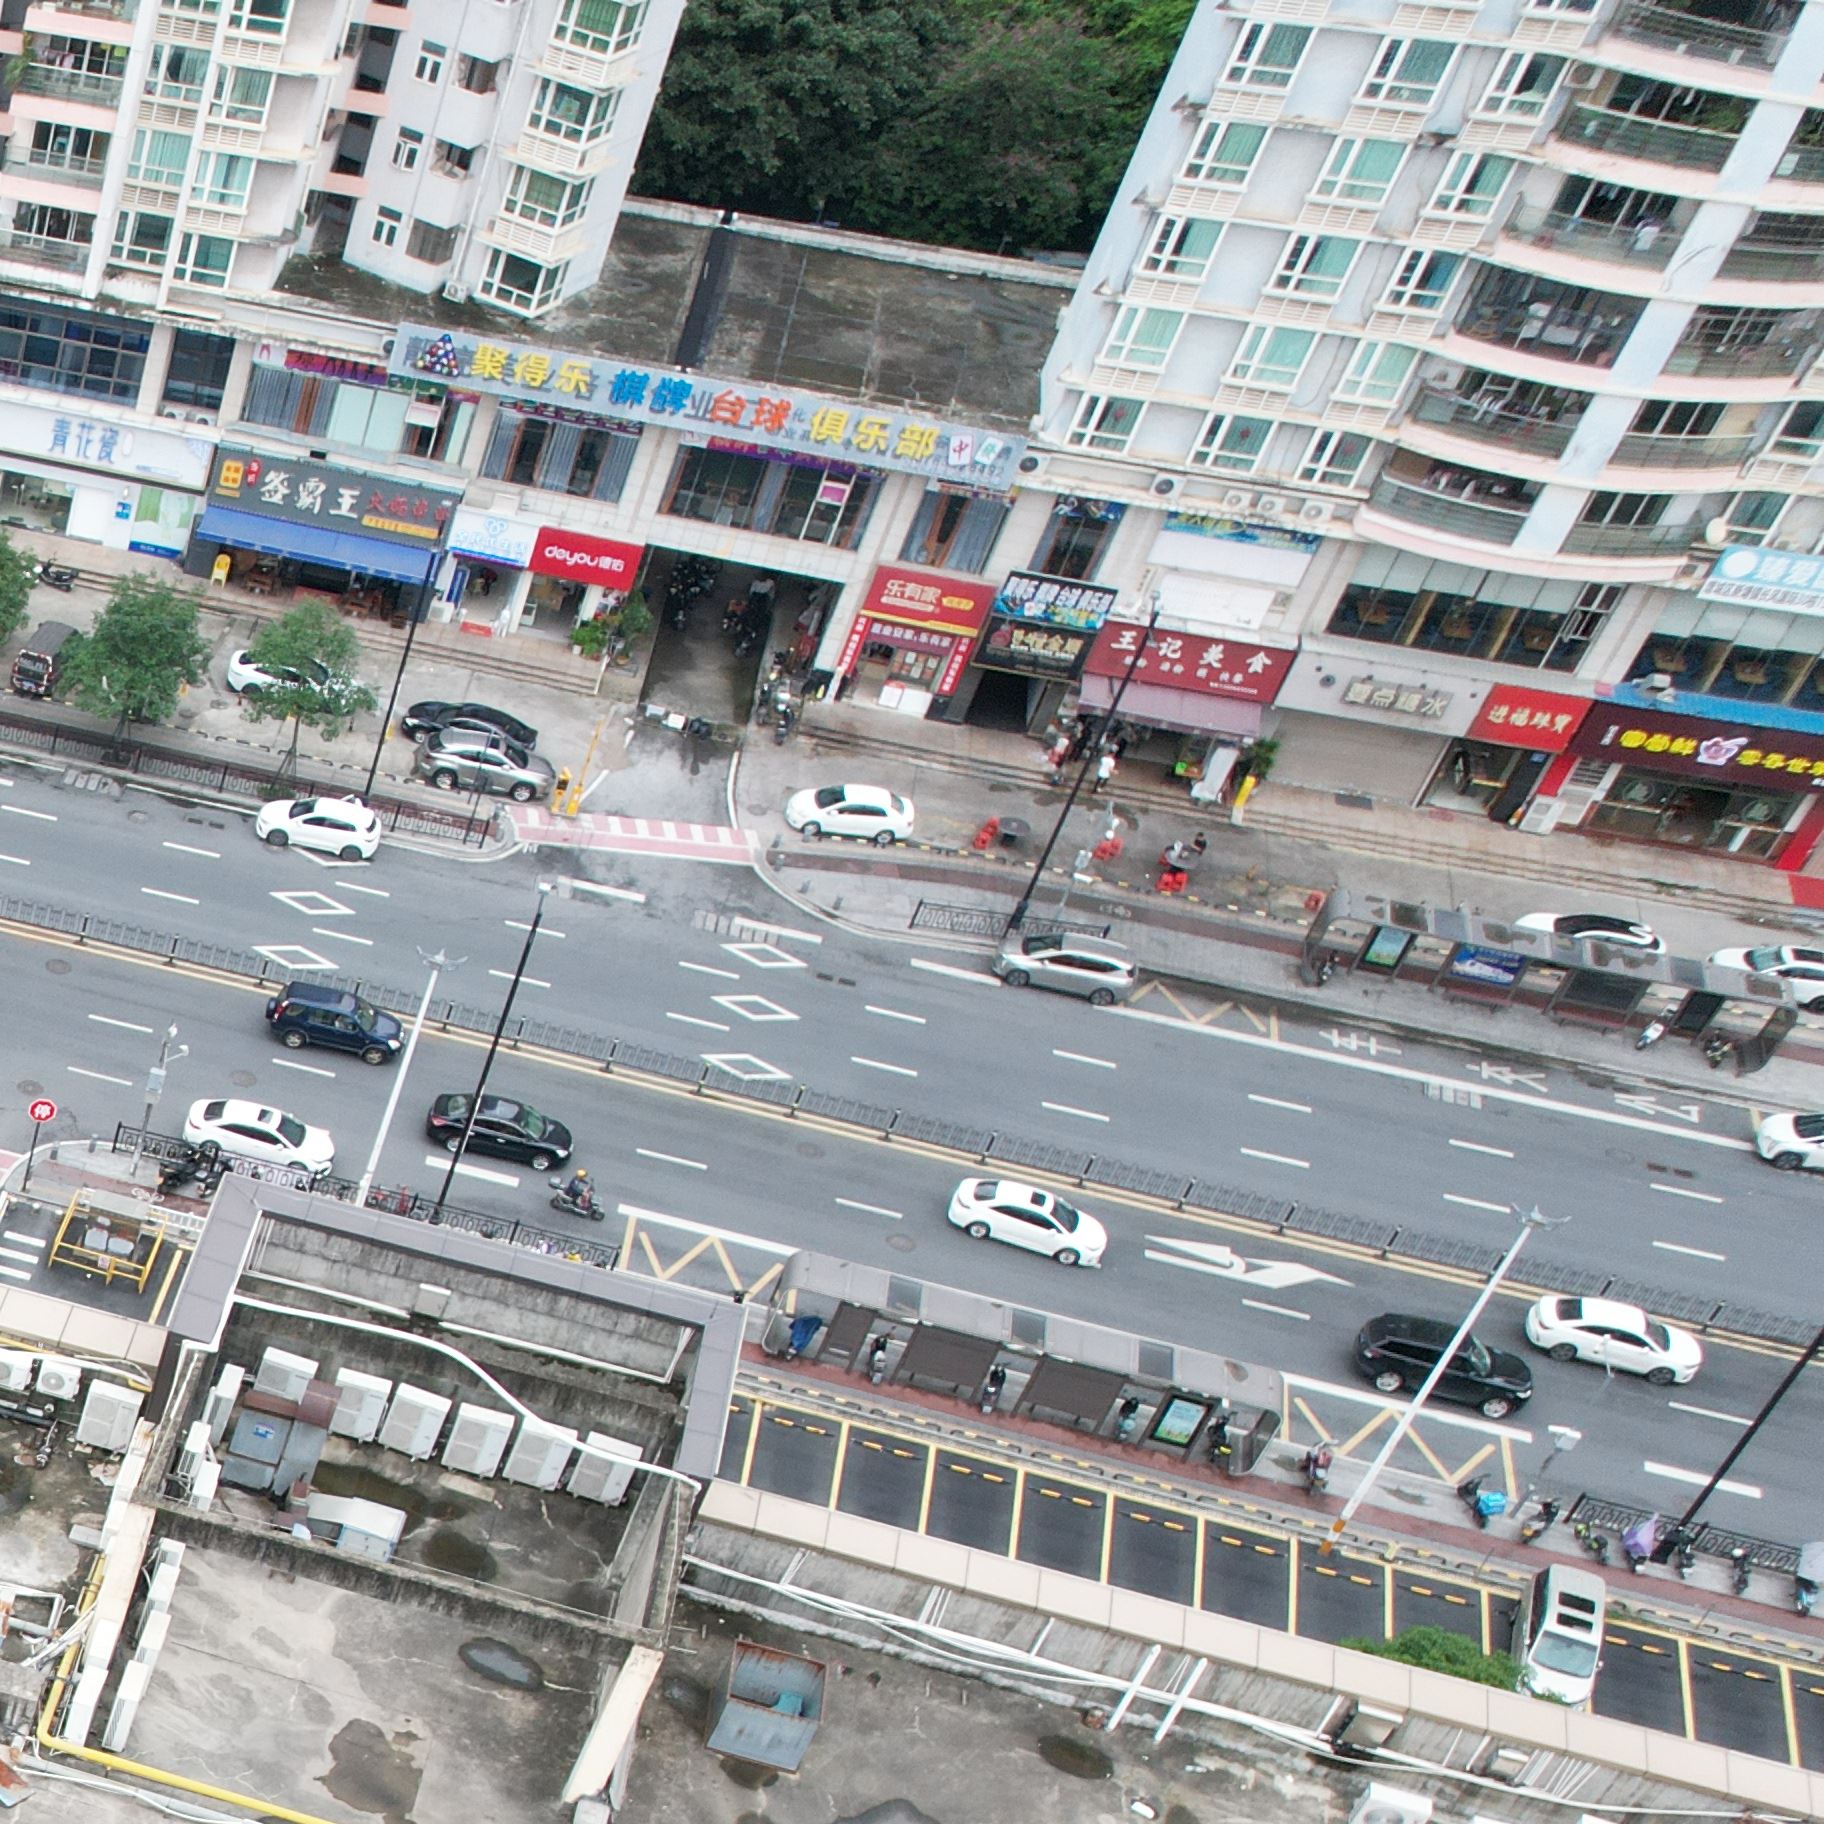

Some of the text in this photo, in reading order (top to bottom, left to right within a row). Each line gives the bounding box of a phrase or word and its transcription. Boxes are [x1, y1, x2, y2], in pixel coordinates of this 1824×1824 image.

[470, 343, 941, 461] 聚得乐 棋牌 台球 俱乐部
[48, 417, 121, 465] 青花瓷
[543, 545, 599, 567] deyou
[884, 579, 943, 605] 乐有家
[1110, 629, 1273, 675] 王记美食
[33, 1103, 53, 1120] 停
